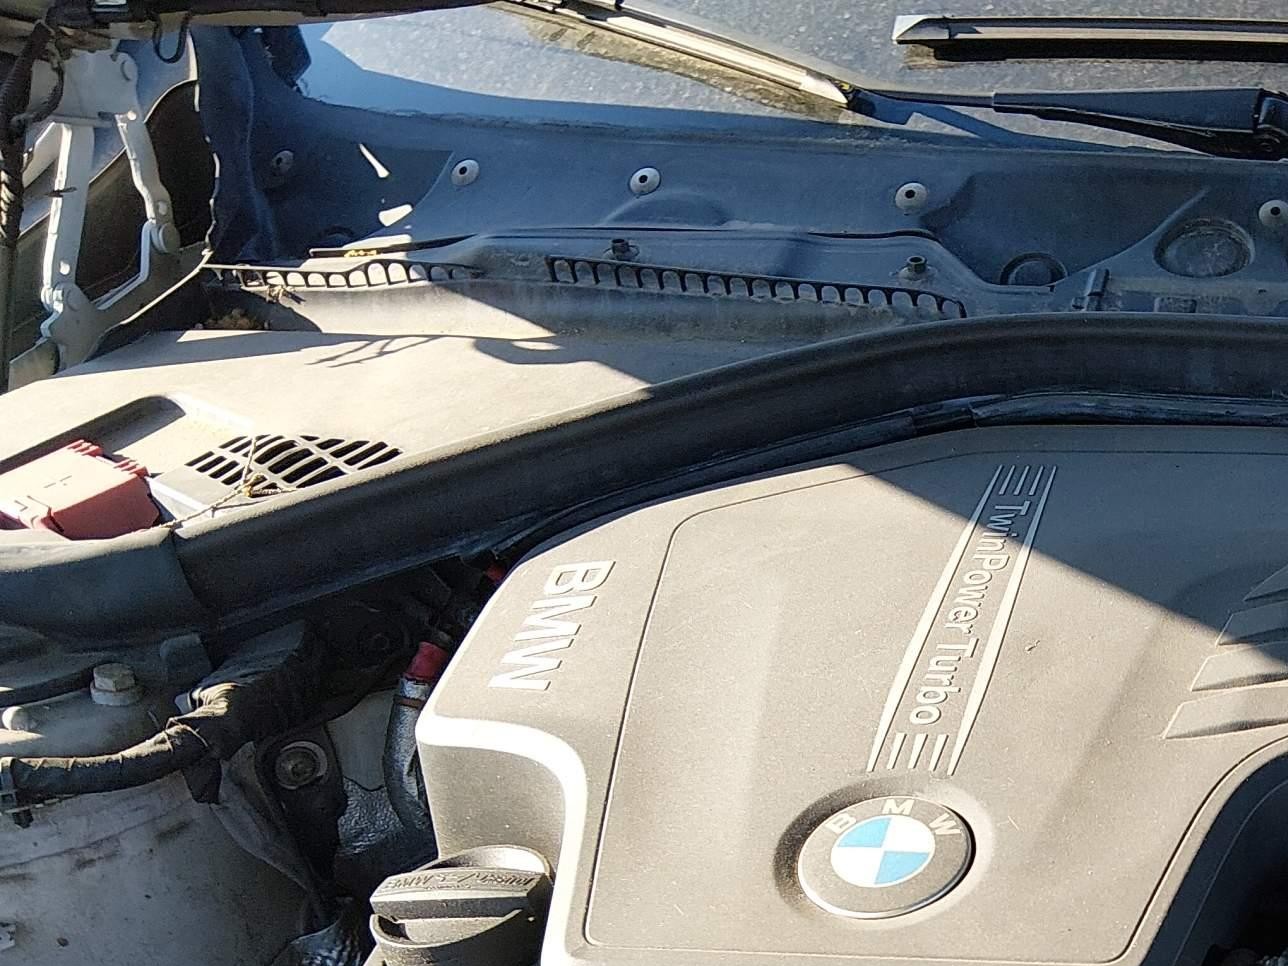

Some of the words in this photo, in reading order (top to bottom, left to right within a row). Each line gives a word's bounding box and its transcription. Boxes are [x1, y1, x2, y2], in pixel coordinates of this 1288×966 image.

[944, 500, 1031, 635] TwinPower
[487, 560, 616, 691] BMW
[910, 638, 979, 725] Turbo
[823, 798, 963, 836] BMW
